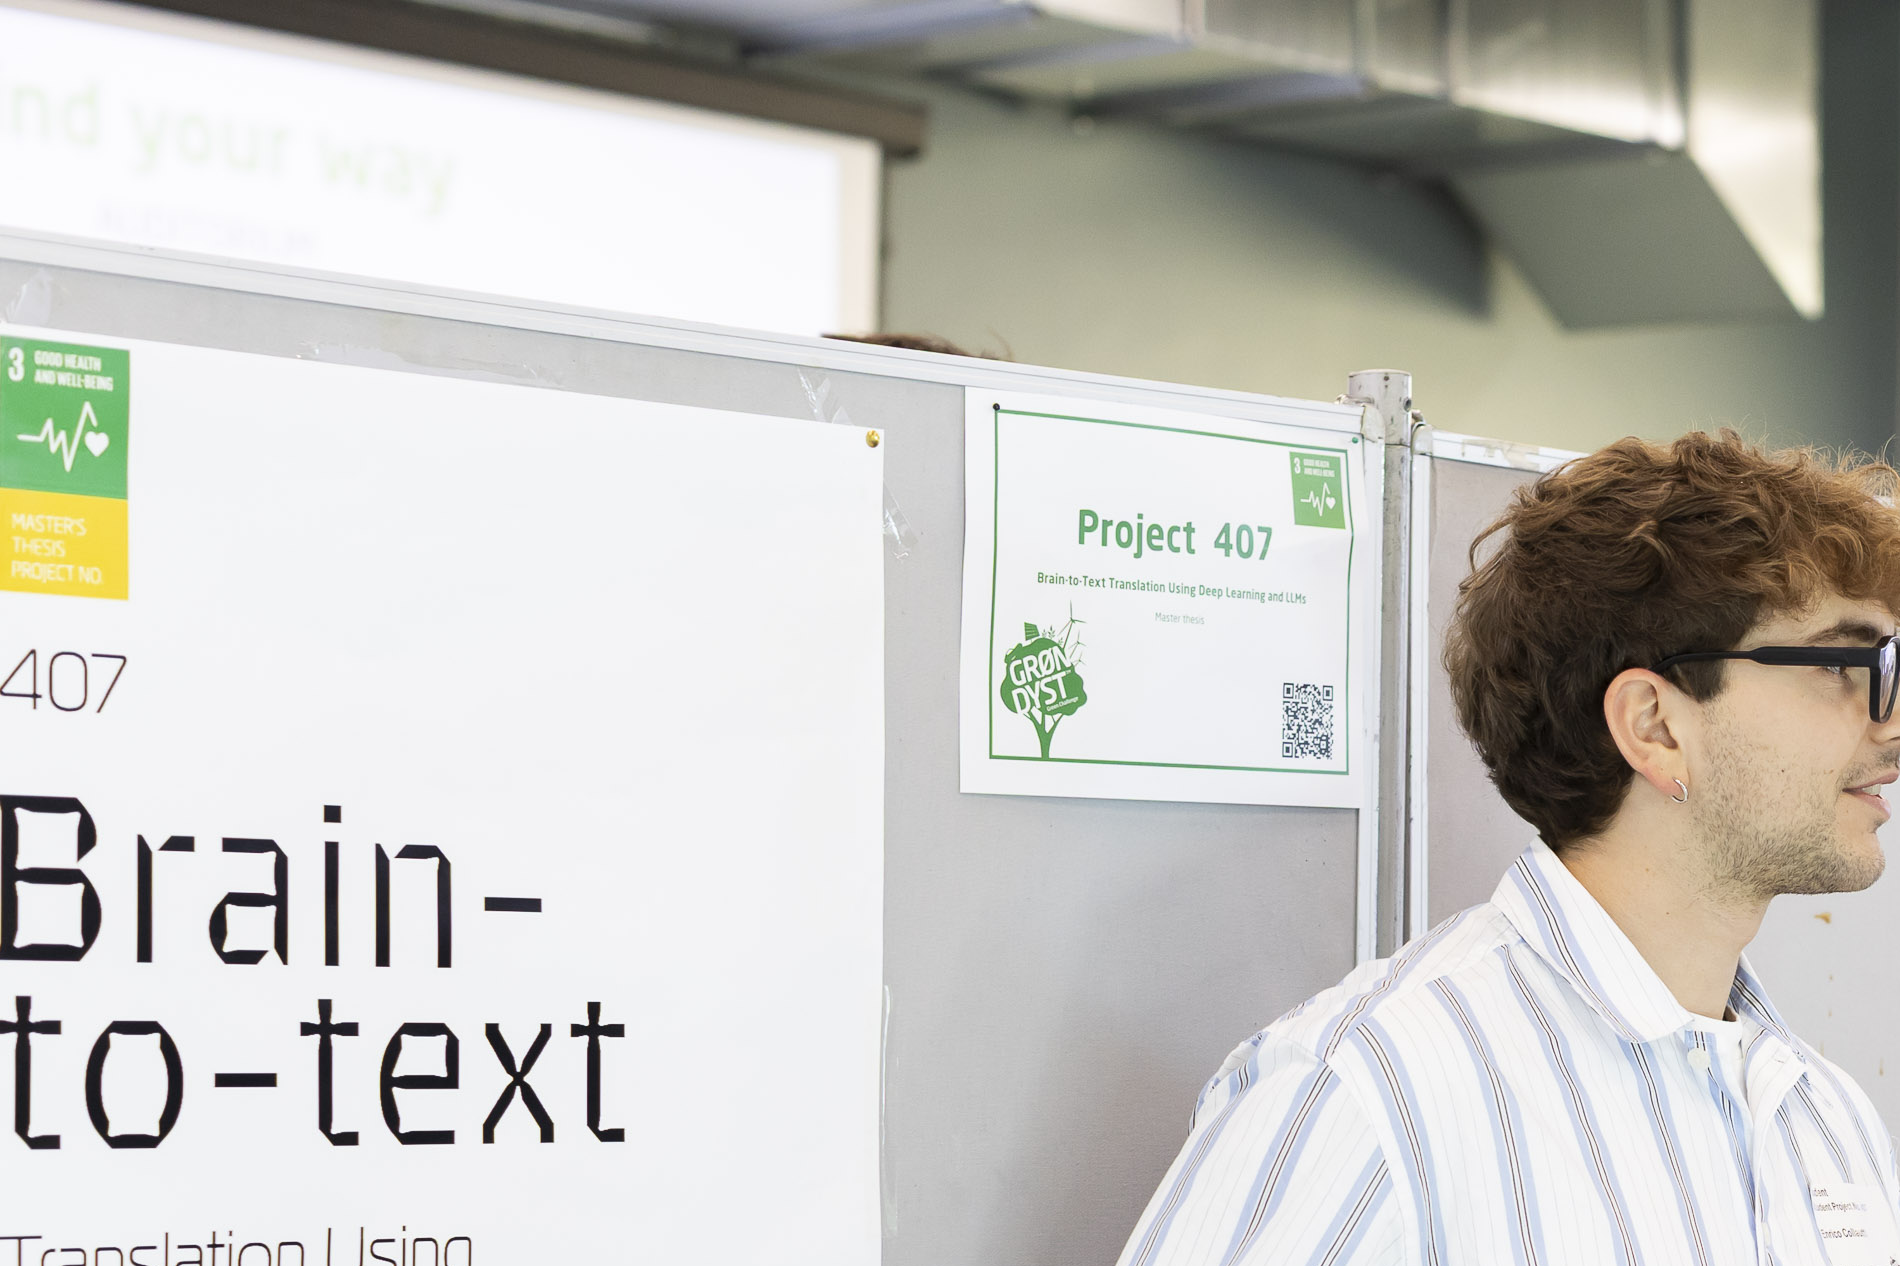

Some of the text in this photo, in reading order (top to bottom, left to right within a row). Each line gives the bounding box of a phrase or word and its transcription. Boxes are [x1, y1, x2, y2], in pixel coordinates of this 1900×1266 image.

[10, 79, 456, 219] nd your way
[8, 347, 102, 382] 3 GOOD HEALTH
[34, 369, 114, 392] AND WELL-BEING
[1294, 457, 1301, 474] 3
[11, 513, 87, 537] MASTER'S
[1079, 508, 1274, 561] Project 407
[12, 536, 66, 558] THESIS
[11, 560, 74, 584] PROJECT
[1037, 571, 1307, 604] Brain-to-Text Translation Using Deep Learning and LLMs
[1155, 612, 1205, 625] Master thesis
[0, 648, 128, 713] 407
[1009, 646, 1072, 686] GRØN
[1011, 671, 1067, 715] DYST
[0, 794, 542, 968] Brain-
[0, 995, 625, 1150] to-text
